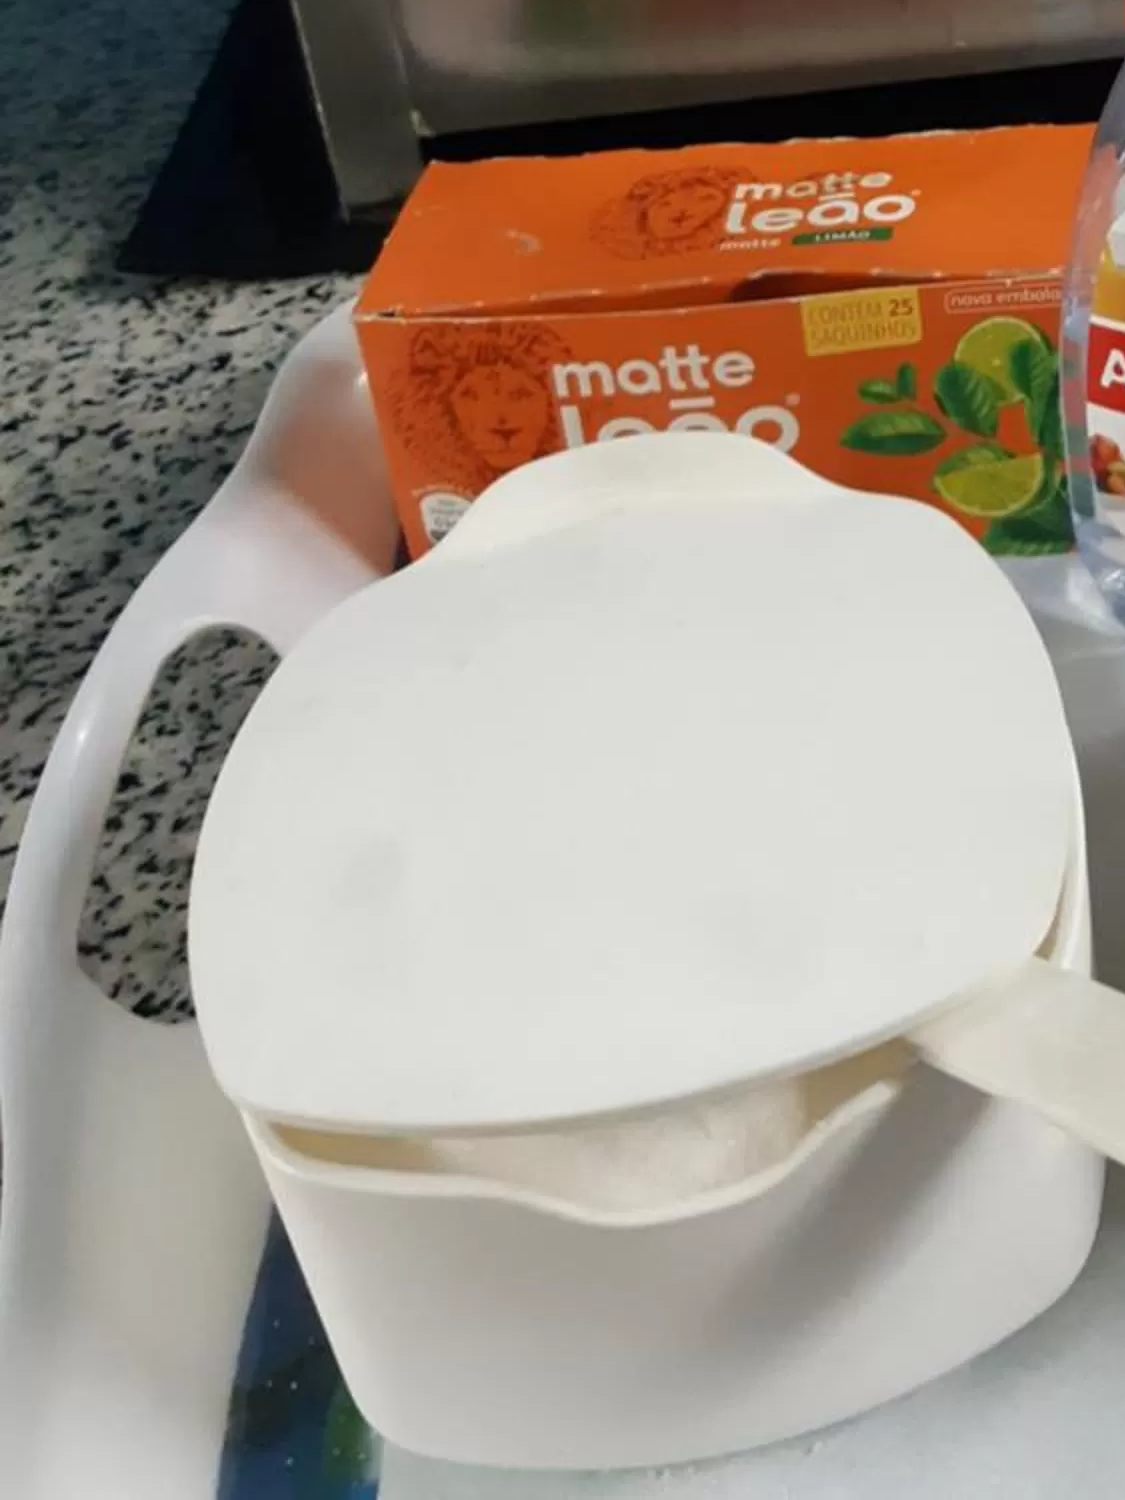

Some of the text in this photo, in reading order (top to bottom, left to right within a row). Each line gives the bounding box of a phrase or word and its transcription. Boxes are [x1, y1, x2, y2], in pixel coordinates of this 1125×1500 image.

[735, 172, 892, 201] matte
[725, 191, 916, 234] leão
[888, 298, 914, 318] 25
[553, 344, 755, 398] matte
